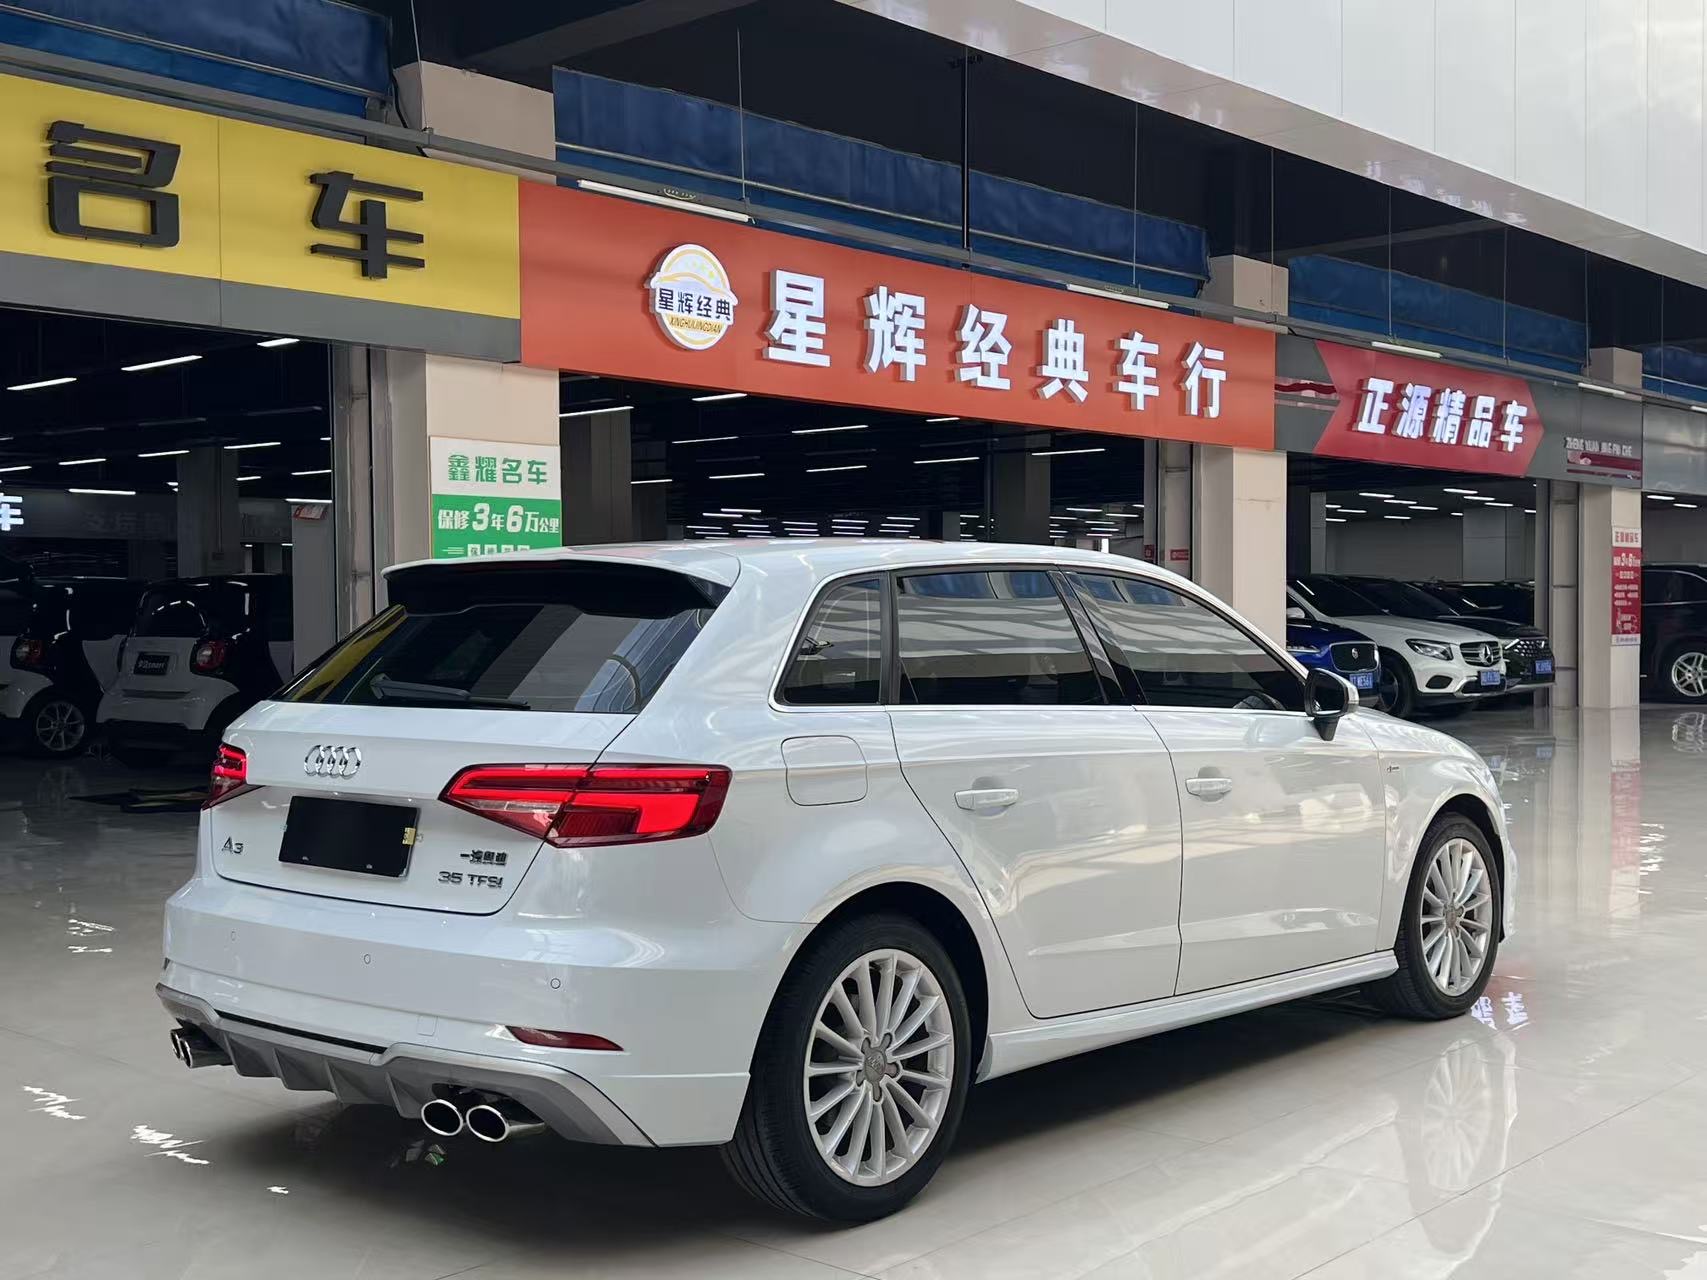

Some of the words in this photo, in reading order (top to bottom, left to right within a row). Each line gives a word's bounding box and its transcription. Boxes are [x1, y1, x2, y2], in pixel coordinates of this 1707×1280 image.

[659, 288, 731, 321] 星辉经典
[763, 269, 1227, 419] 星辉经典车行
[1357, 377, 1529, 452] 正源精品车
[447, 454, 548, 485] 鑫耀名车
[438, 502, 560, 534] 保修3年6万公里
[221, 836, 244, 854] A3
[438, 871, 463, 884] 35
[467, 874, 503, 888] TFSI
